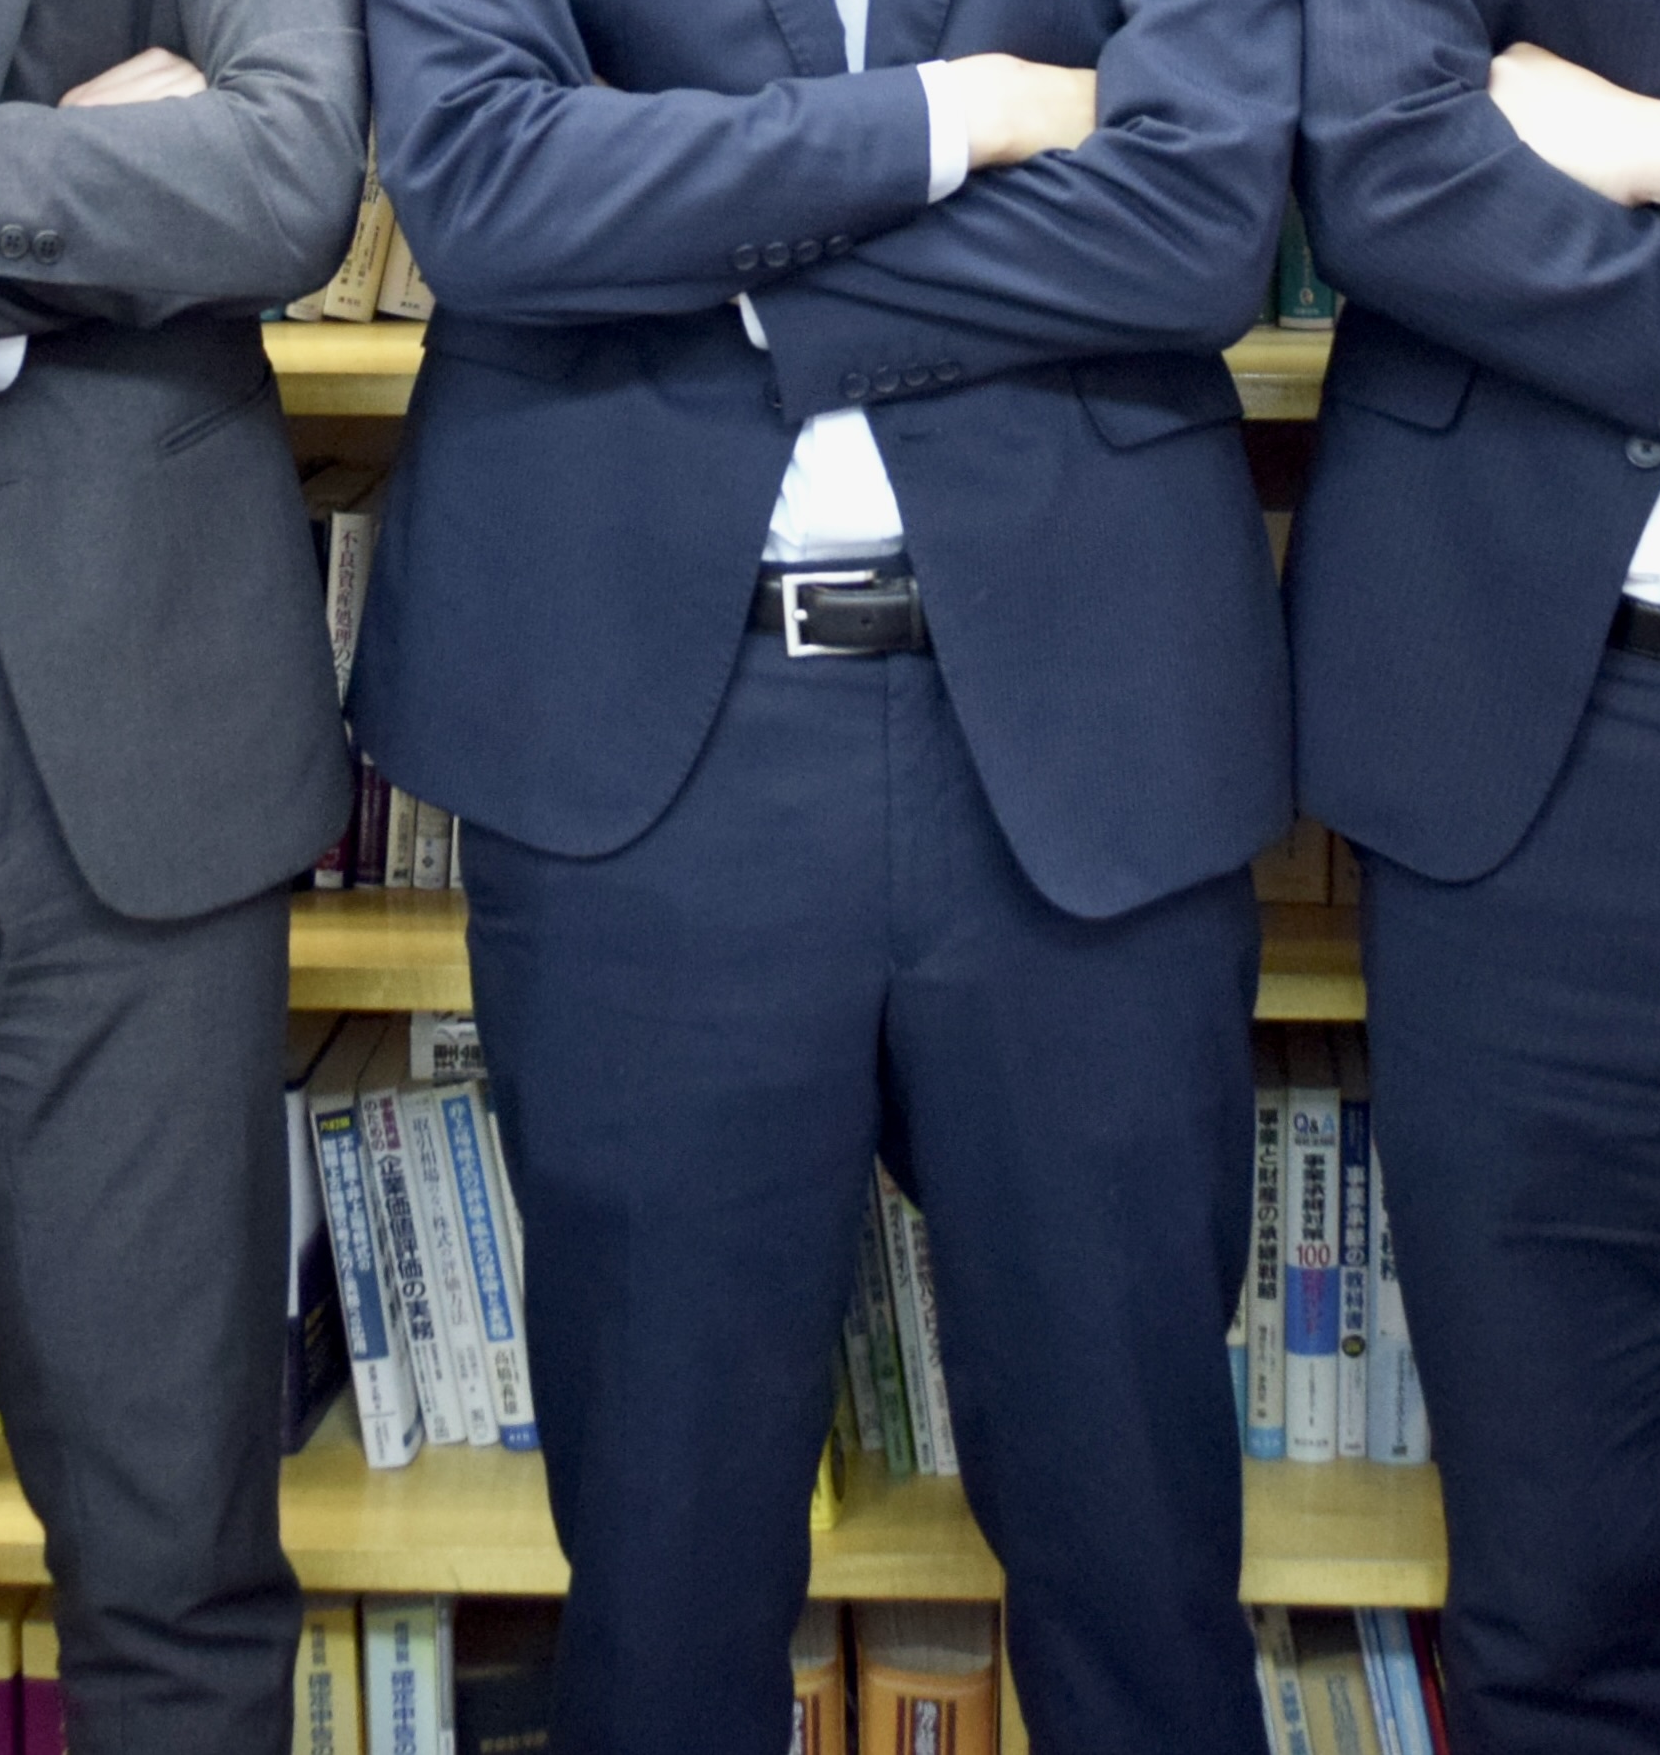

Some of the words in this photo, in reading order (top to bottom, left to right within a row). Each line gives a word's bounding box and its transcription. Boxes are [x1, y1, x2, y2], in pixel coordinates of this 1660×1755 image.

[377, 1154, 435, 1341] 企業価値評価の実務
[1295, 1244, 1331, 1267] 100
